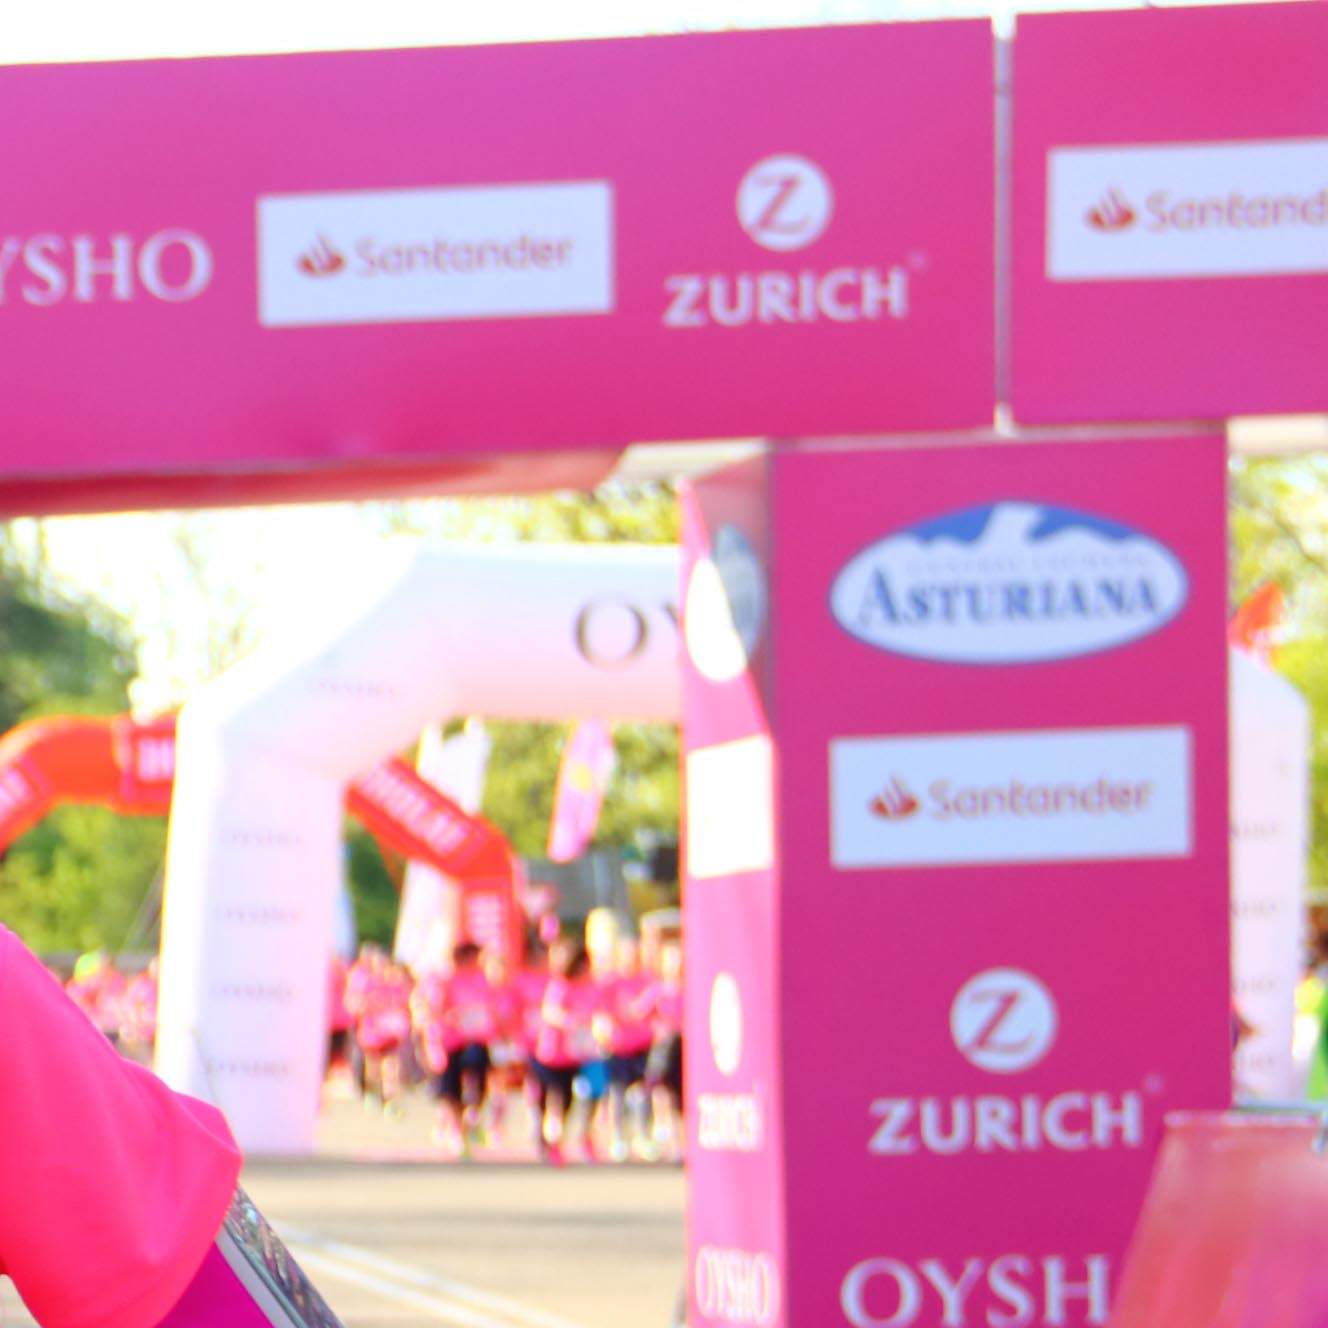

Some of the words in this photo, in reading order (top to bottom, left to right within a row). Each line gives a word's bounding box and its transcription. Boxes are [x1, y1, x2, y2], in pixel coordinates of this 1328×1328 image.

[1145, 184, 1328, 235] Santand
[355, 233, 575, 279] Santander
[662, 266, 909, 327] ZURICH
[858, 566, 1160, 628] ASTURIANA
[929, 775, 1153, 820] Santander
[868, 1091, 1143, 1155] ZURICH
